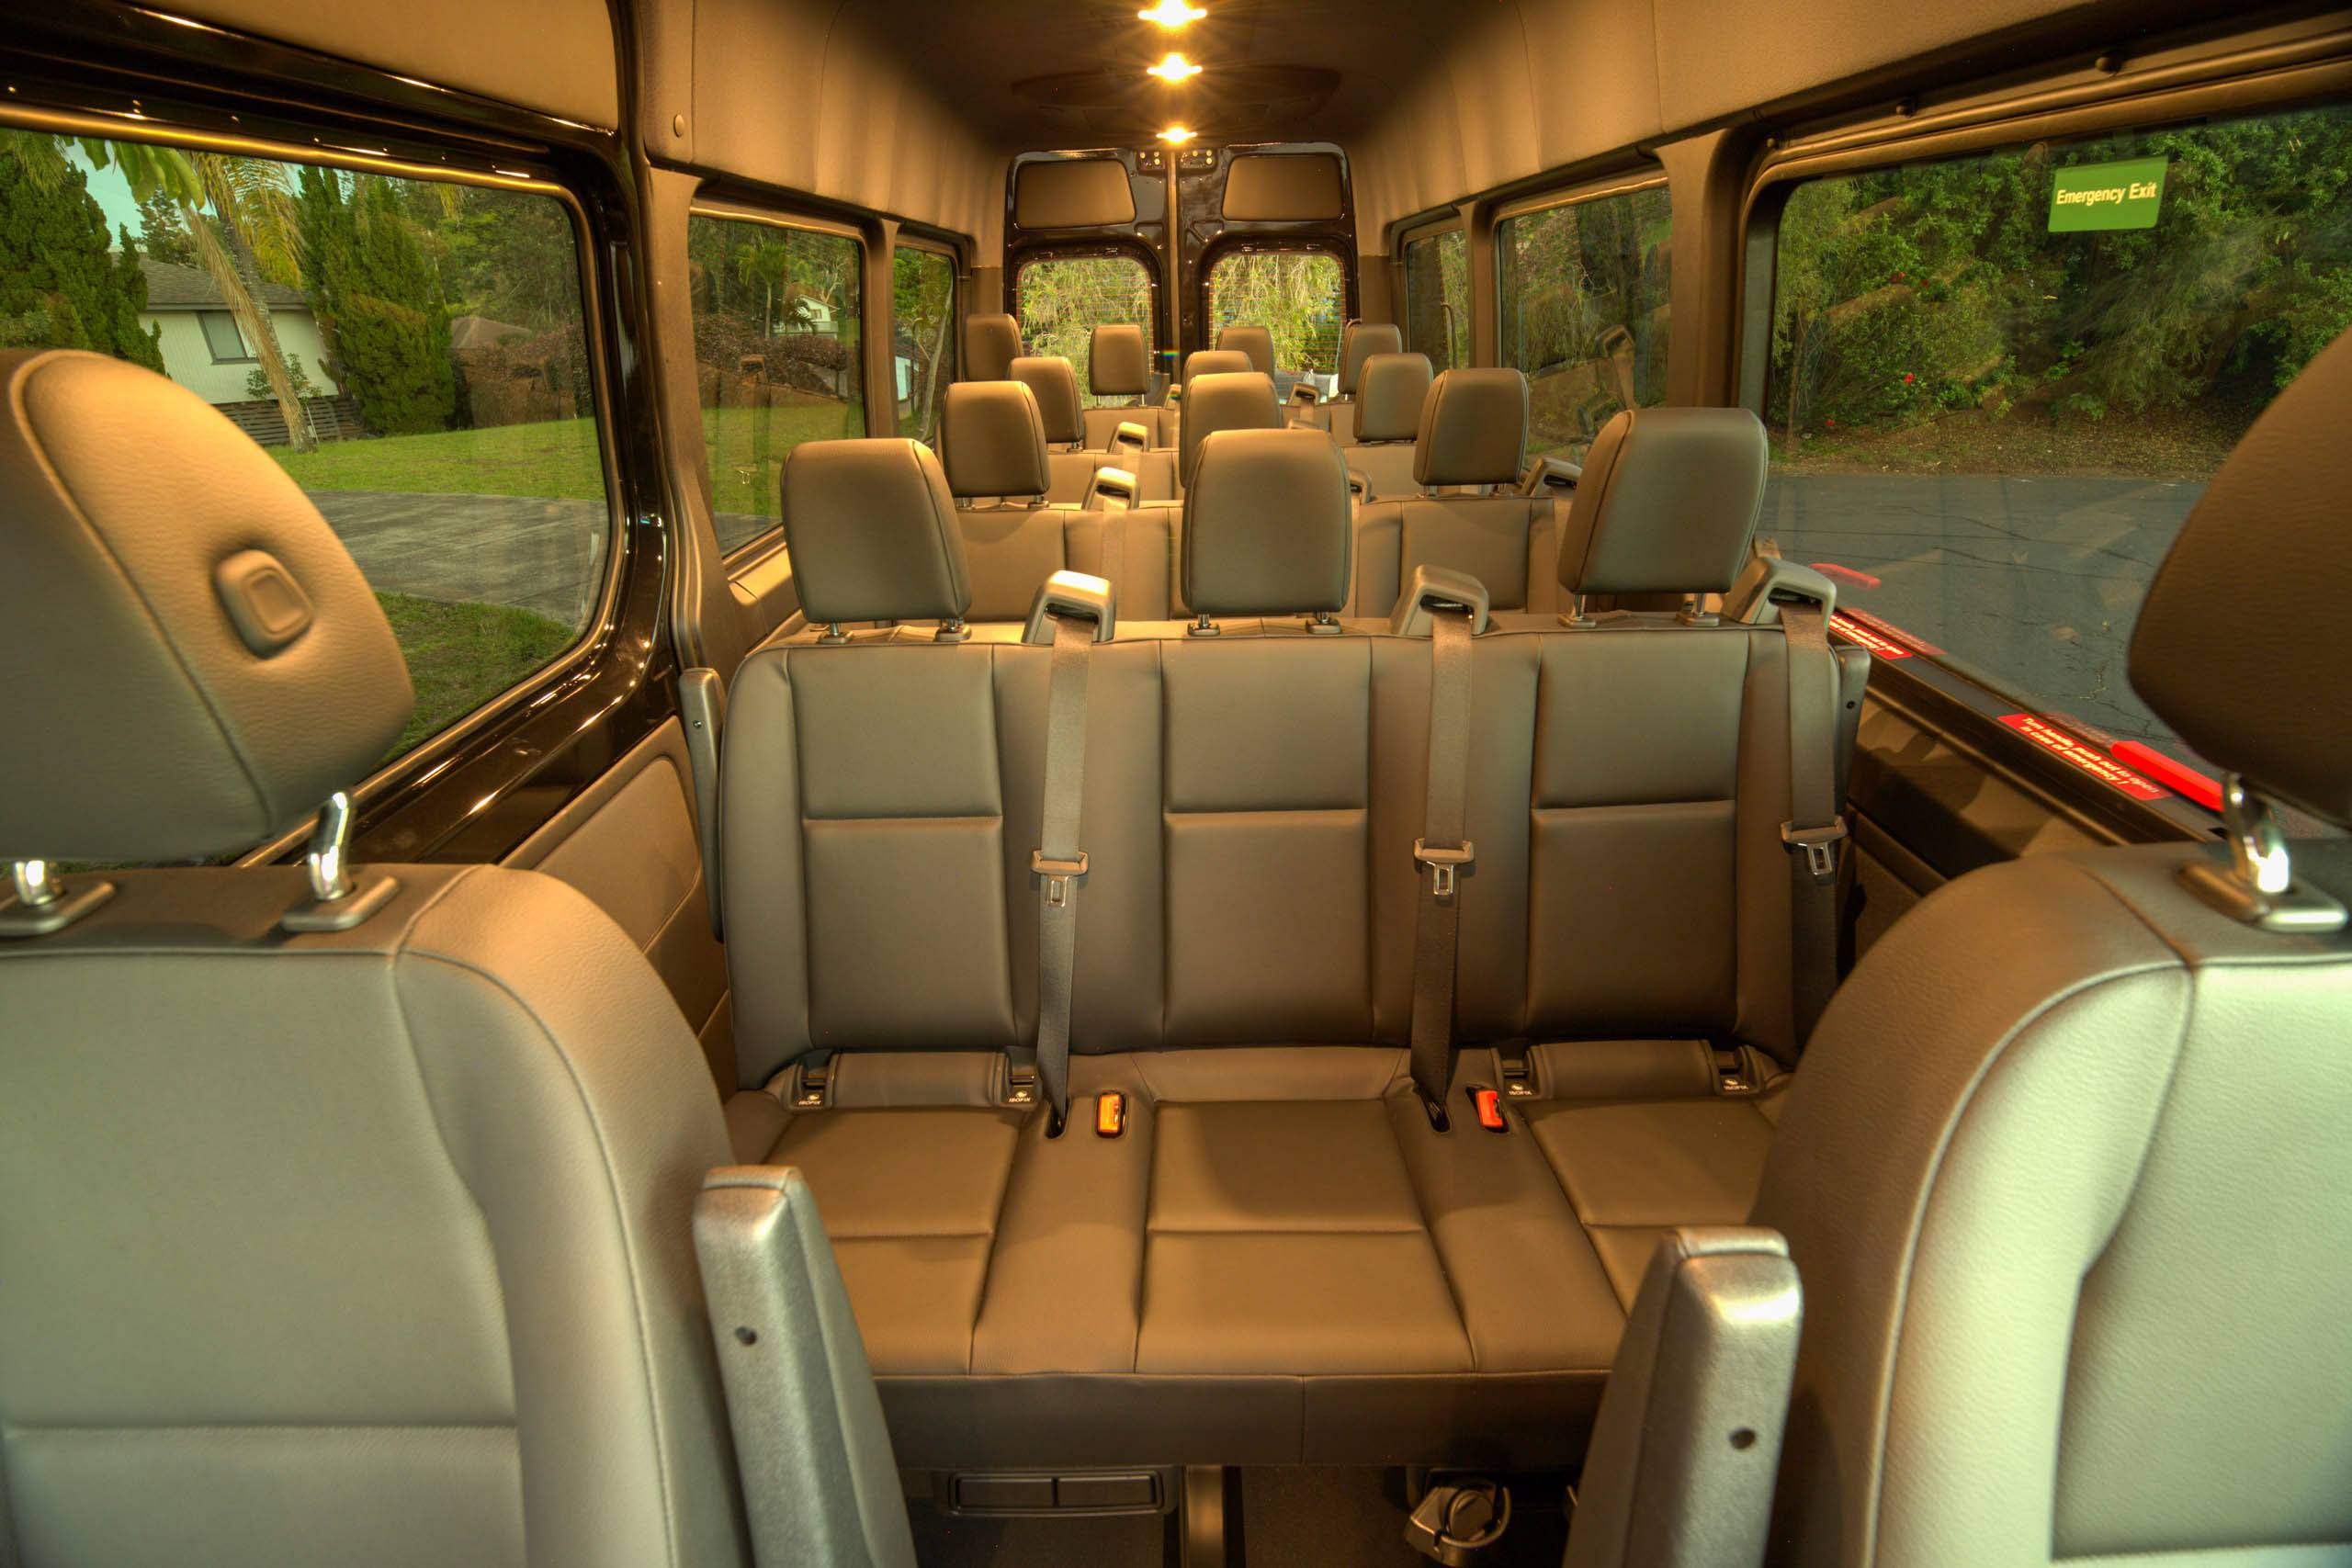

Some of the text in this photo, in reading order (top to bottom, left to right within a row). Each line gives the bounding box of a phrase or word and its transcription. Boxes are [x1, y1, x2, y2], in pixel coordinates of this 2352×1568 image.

[2056, 182, 2157, 206] Emergency Exit
[2021, 717, 2044, 730] Turn
[2071, 747, 2102, 761] push
[2098, 761, 2121, 772] out
[2116, 770, 2132, 778] to
[2128, 777, 2160, 793] open
[2029, 731, 2055, 745] case
[2051, 743, 2070, 751] of
[2062, 750, 2121, 781] emergency
